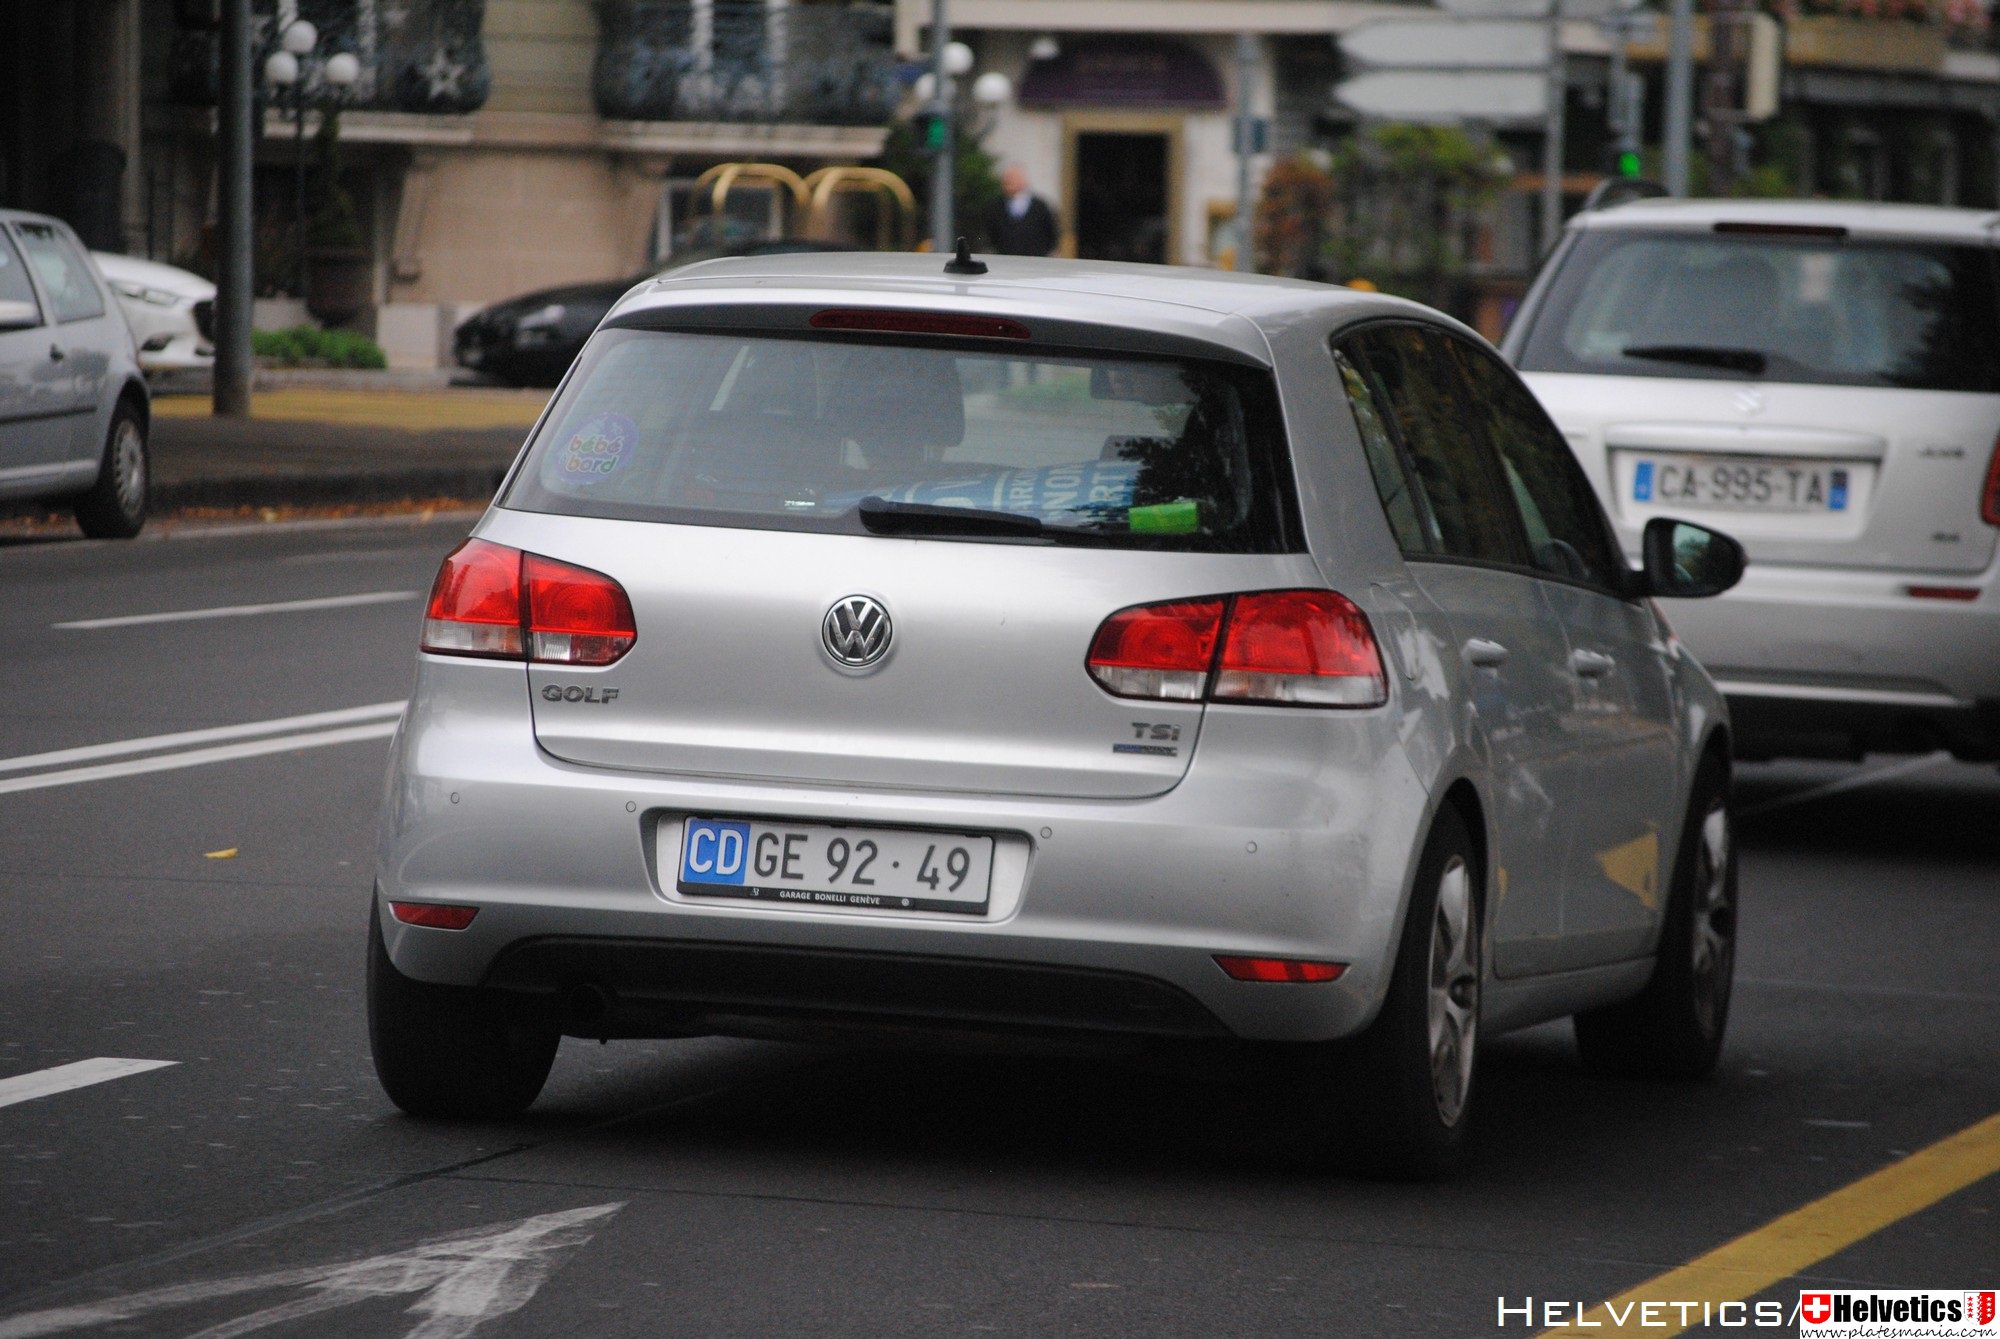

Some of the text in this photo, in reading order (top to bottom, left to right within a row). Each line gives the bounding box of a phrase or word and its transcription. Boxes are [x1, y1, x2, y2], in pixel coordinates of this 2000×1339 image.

[566, 453, 620, 475] bord
[1659, 465, 1823, 503] CA-995-TA
[541, 684, 619, 704] GOLF
[689, 828, 743, 876] CD
[753, 832, 808, 881] GE
[779, 890, 811, 901] GARAGE
[814, 892, 846, 903] BONELLI
